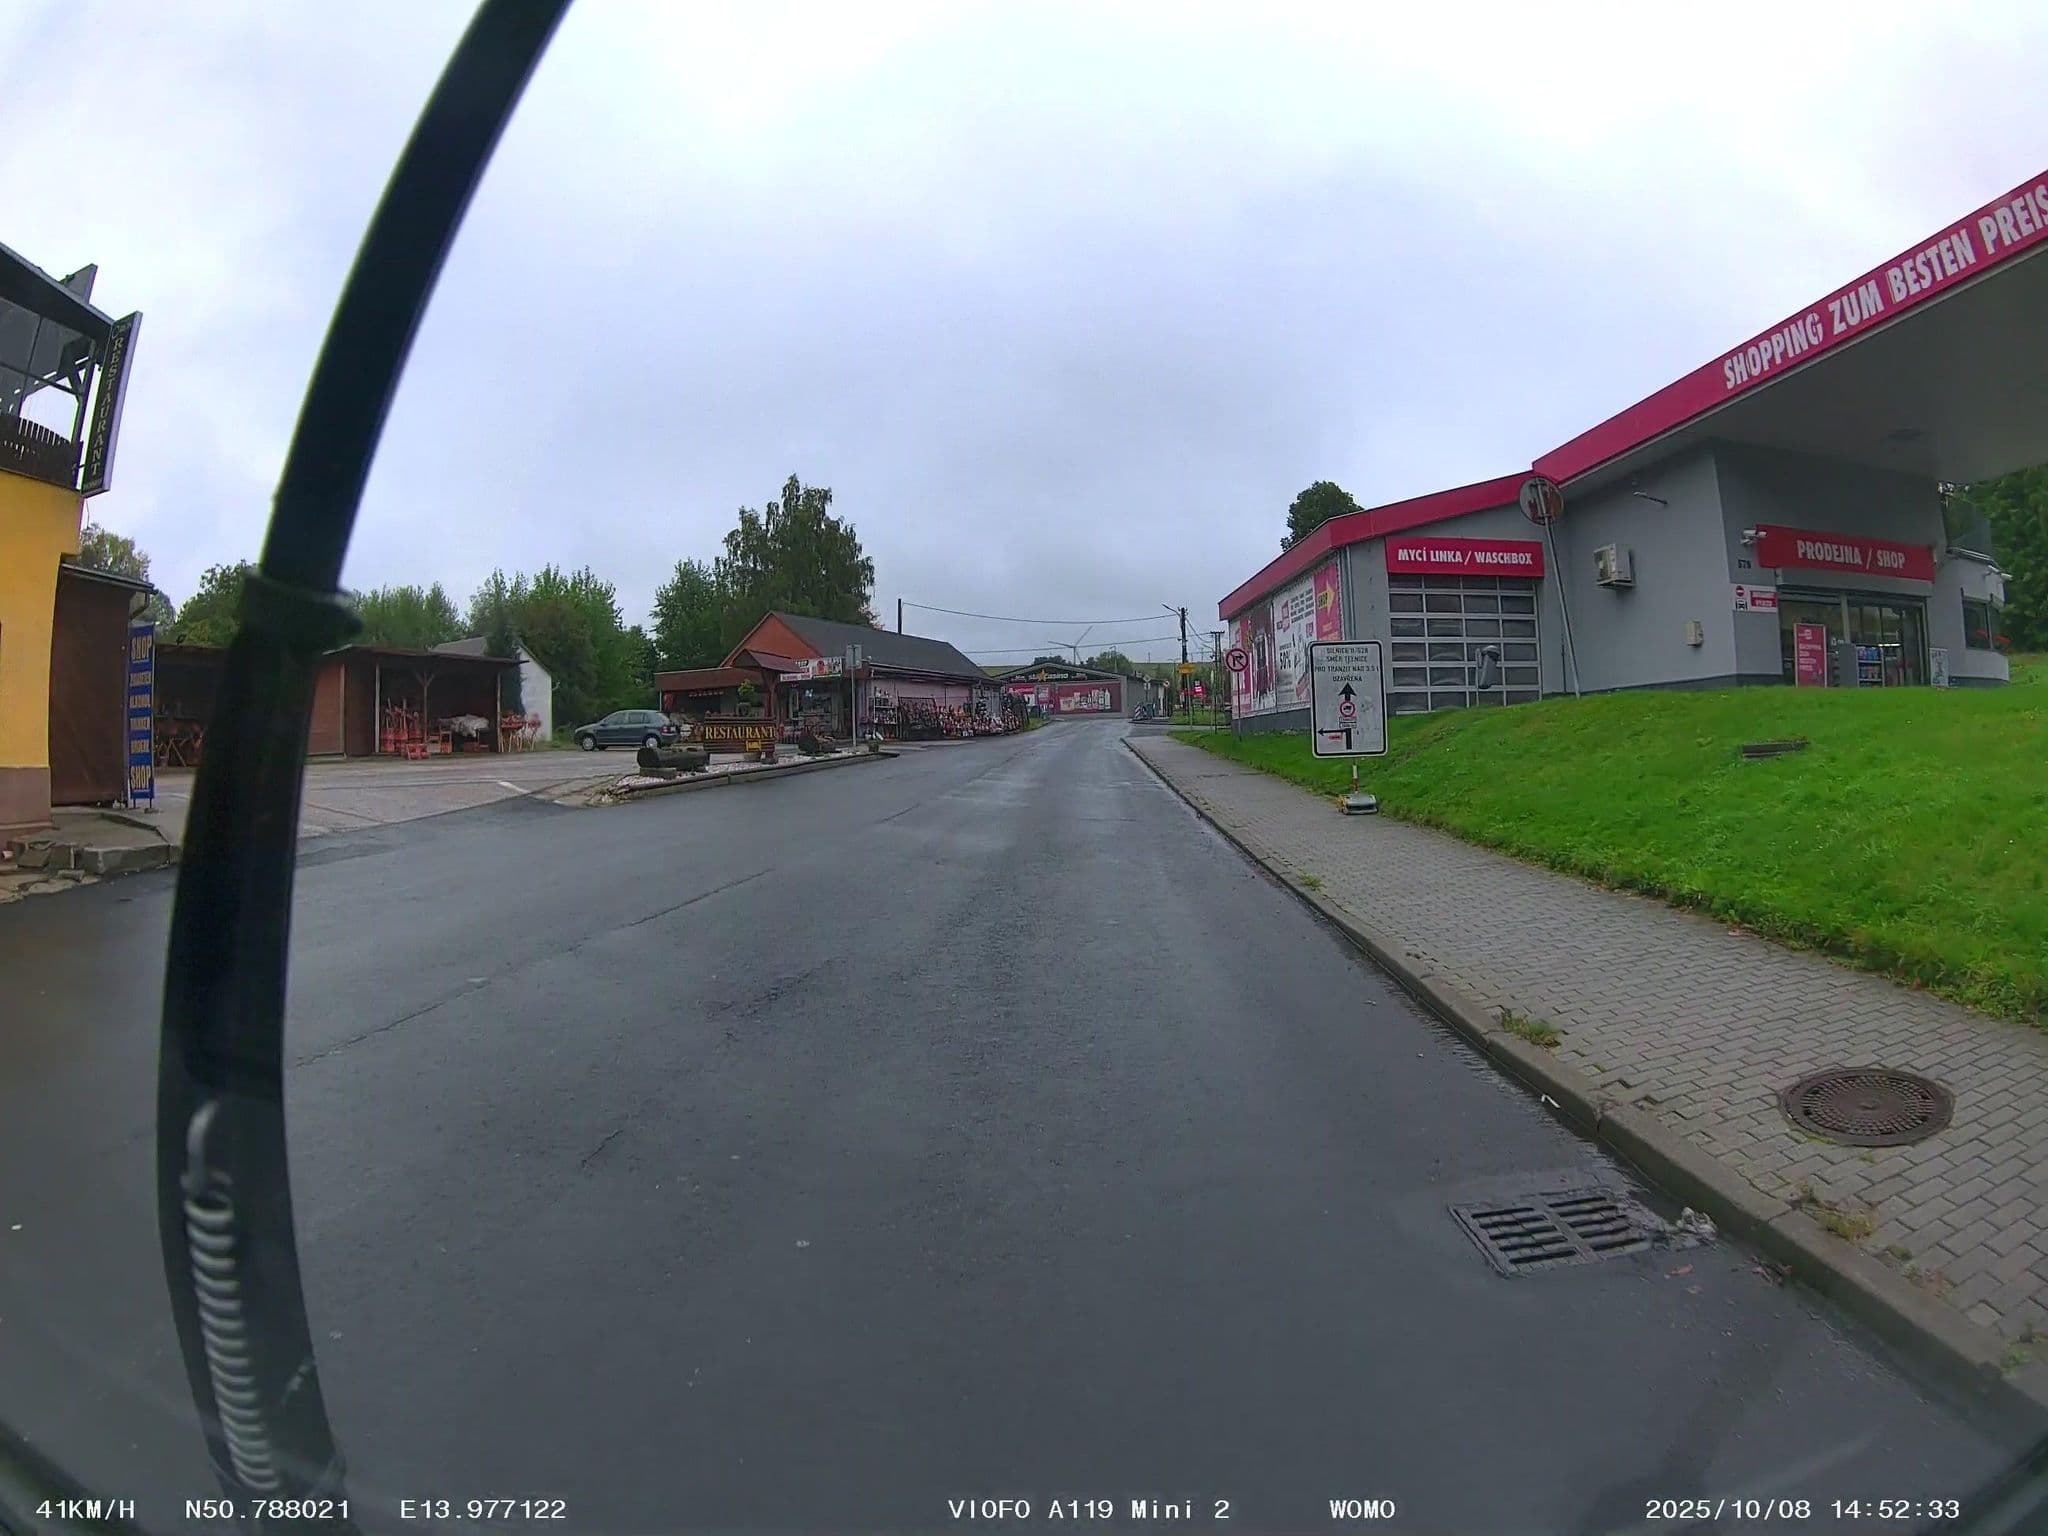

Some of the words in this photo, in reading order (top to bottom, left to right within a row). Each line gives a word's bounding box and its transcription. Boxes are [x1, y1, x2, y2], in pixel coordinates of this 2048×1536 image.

[1723, 312, 1824, 390] SHOPPING
[1828, 279, 1885, 336] ZUM
[1886, 228, 1977, 304] BESTEN
[1978, 184, 2048, 255] PREIS
[91, 337, 124, 476] RESTAURANT
[1430, 550, 1463, 563] LINKA
[1474, 551, 1533, 565] WASCHBOX
[1796, 539, 1863, 566] PRODEJNA
[1876, 549, 1906, 569] SHOP
[131, 635, 152, 660] SHOP
[705, 726, 776, 740] RESTAURANT
[130, 764, 152, 790] SHOP
